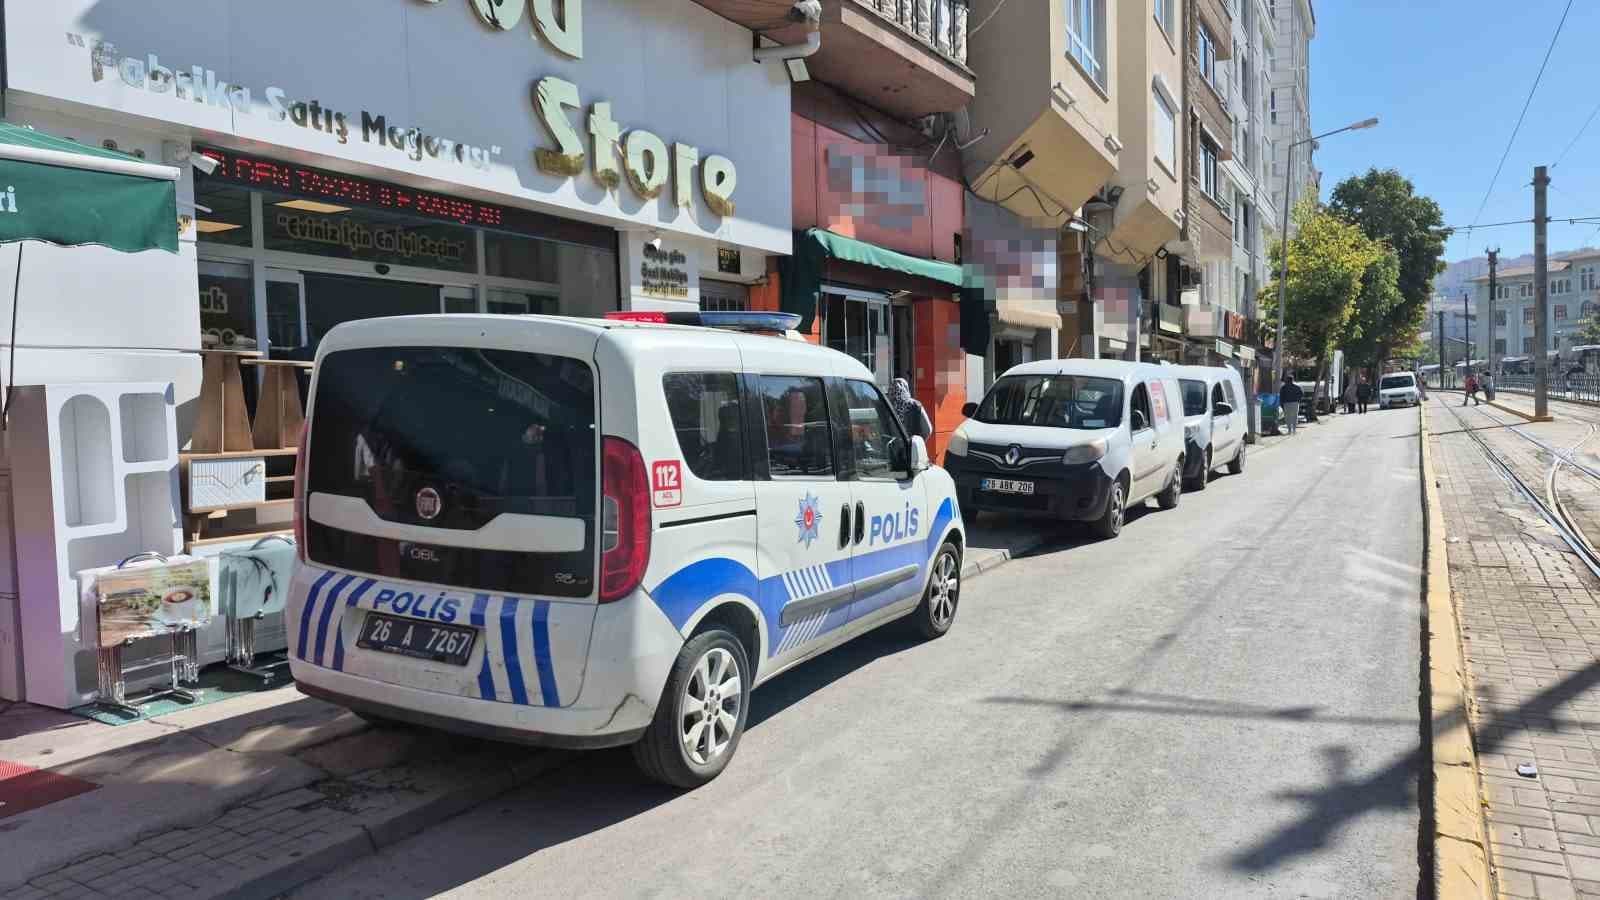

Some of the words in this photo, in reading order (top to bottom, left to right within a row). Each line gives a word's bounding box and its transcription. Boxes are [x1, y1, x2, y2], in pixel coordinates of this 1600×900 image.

[265, 86, 349, 144] Satış
[533, 76, 737, 218] Store
[656, 465, 678, 488] 112
[870, 501, 919, 546] POLİS
[373, 589, 462, 623] POLİS
[370, 619, 393, 642] 26
[401, 625, 415, 647] A
[426, 628, 471, 655] 7267
